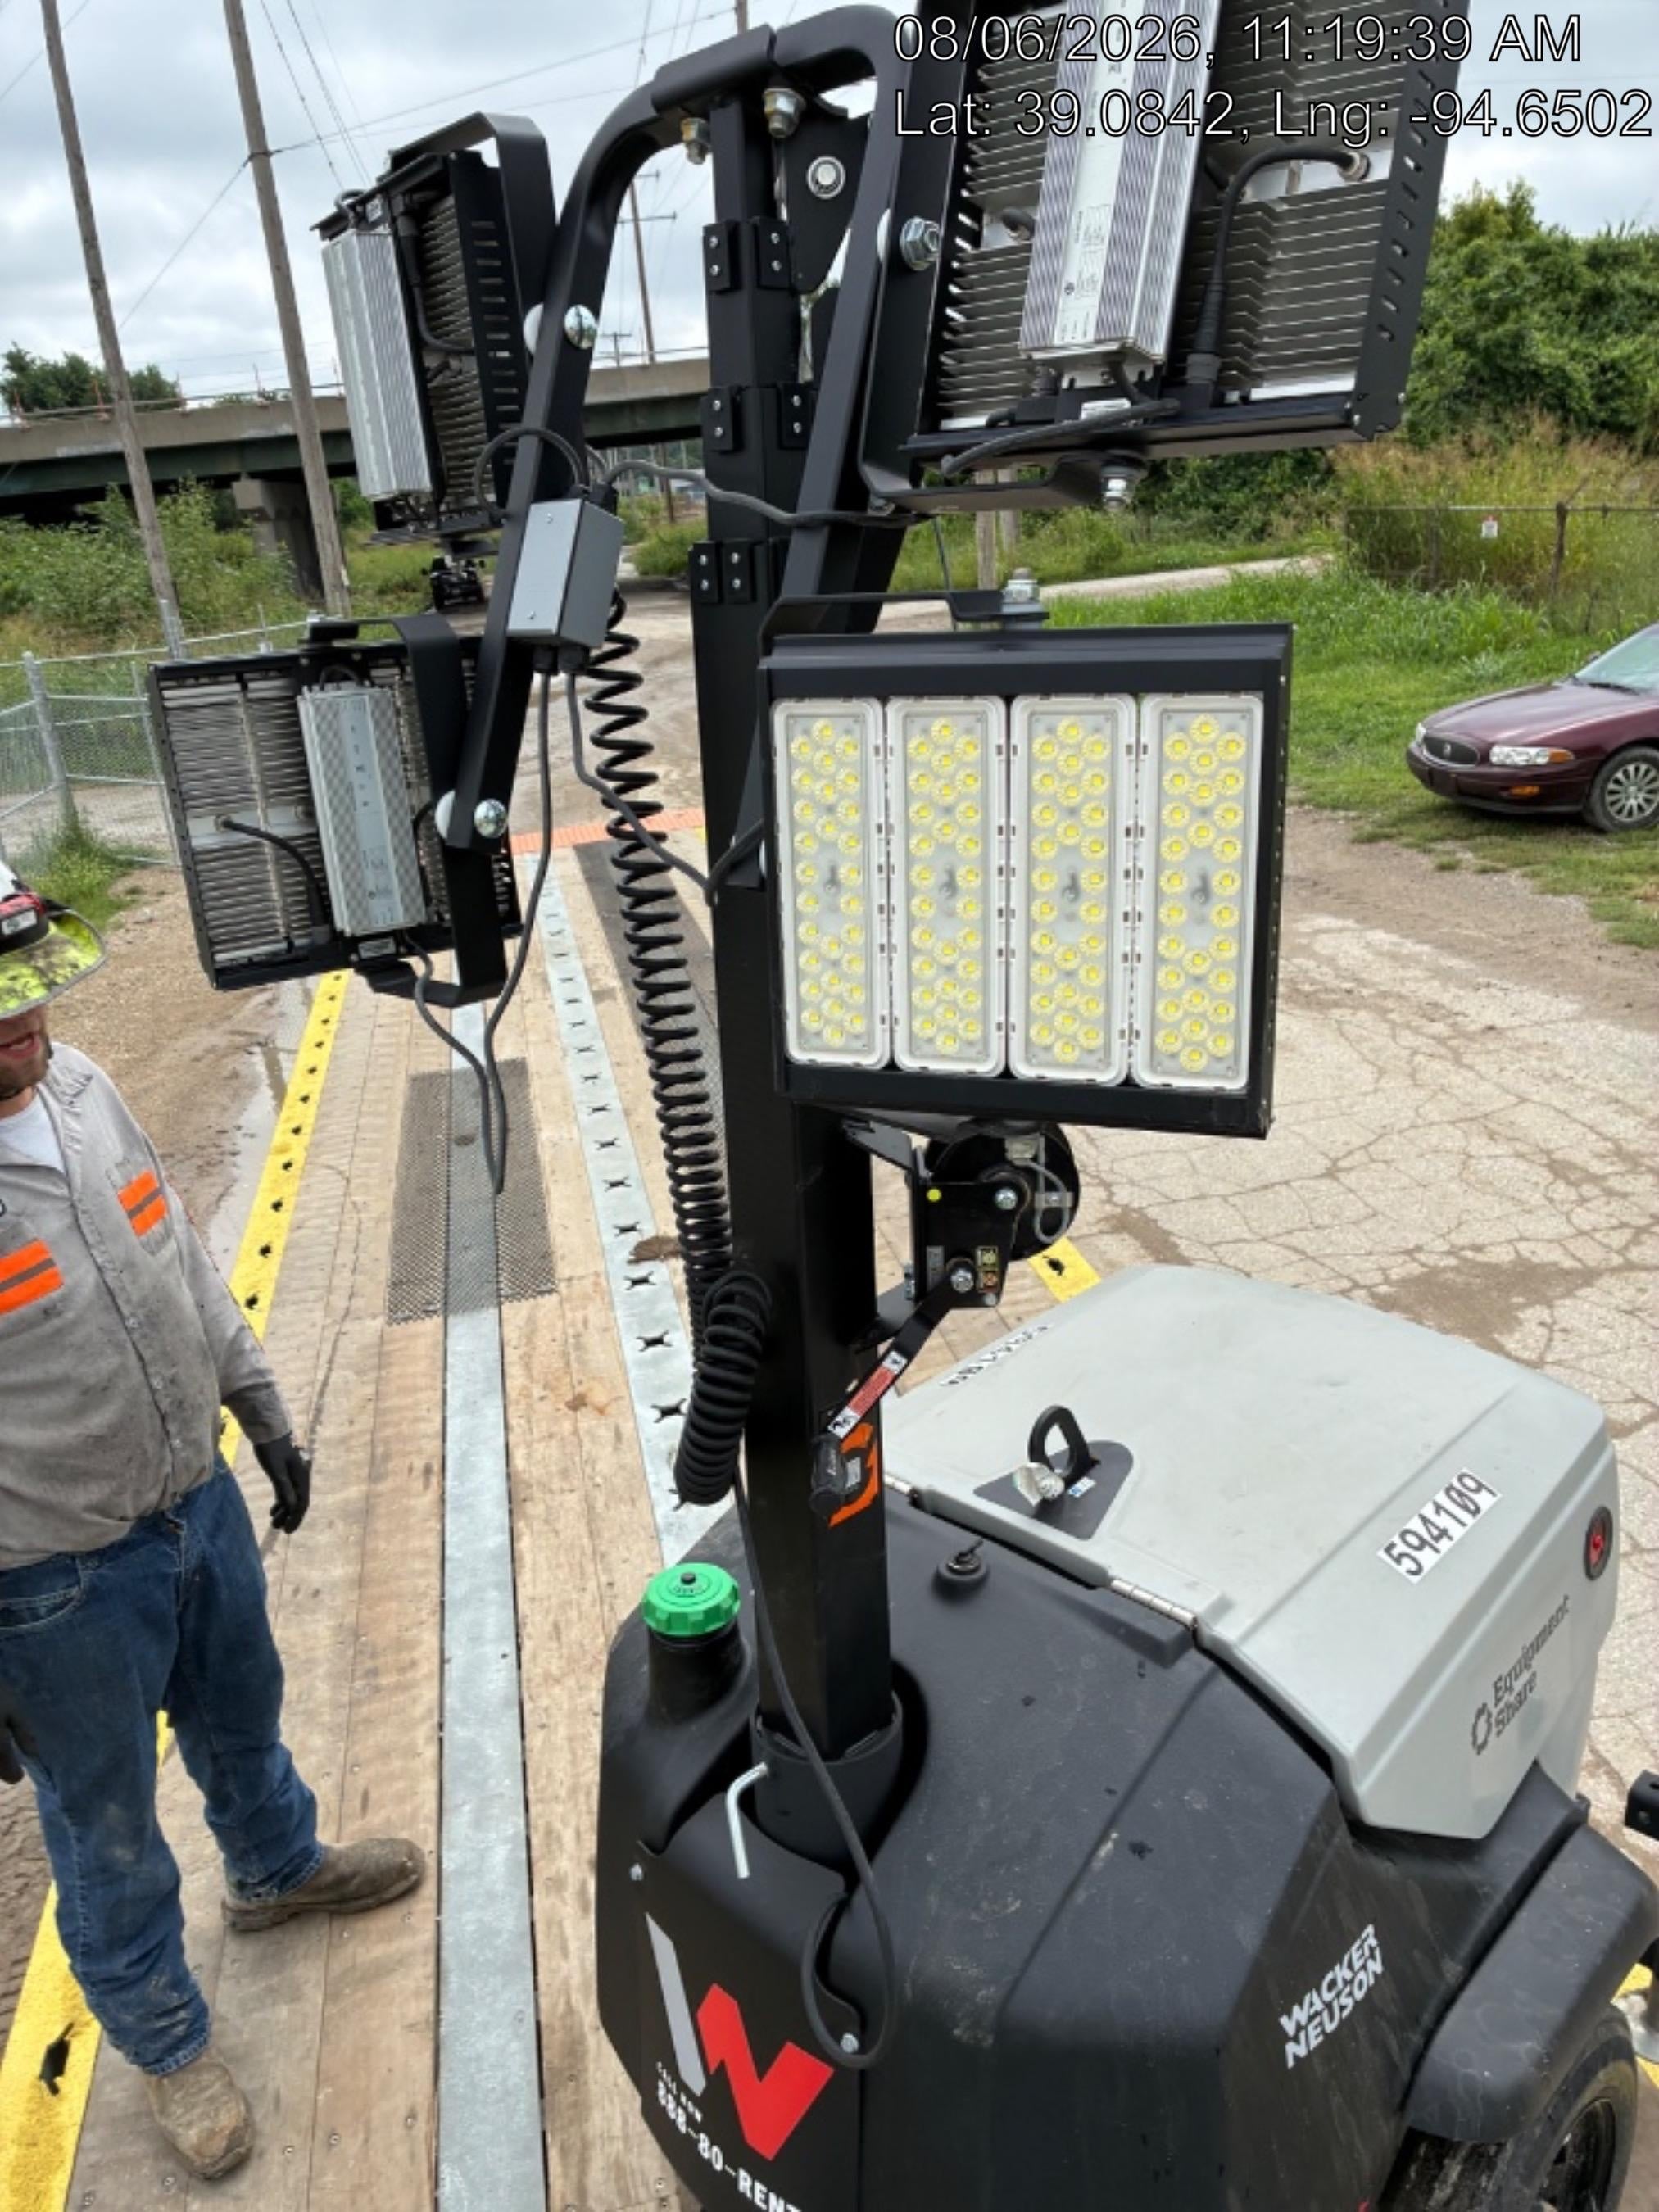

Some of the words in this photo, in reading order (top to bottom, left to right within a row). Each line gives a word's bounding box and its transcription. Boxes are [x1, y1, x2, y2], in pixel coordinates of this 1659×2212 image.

[1383, 1471, 1498, 1577] 594109
[1492, 1593, 1570, 1708] Equipment
[1494, 1670, 1538, 1738] Share
[1278, 1923, 1379, 2038] WACKER
[1284, 1945, 1385, 2070] NEUSON
[657, 2078, 805, 2212] 888-80-REN
